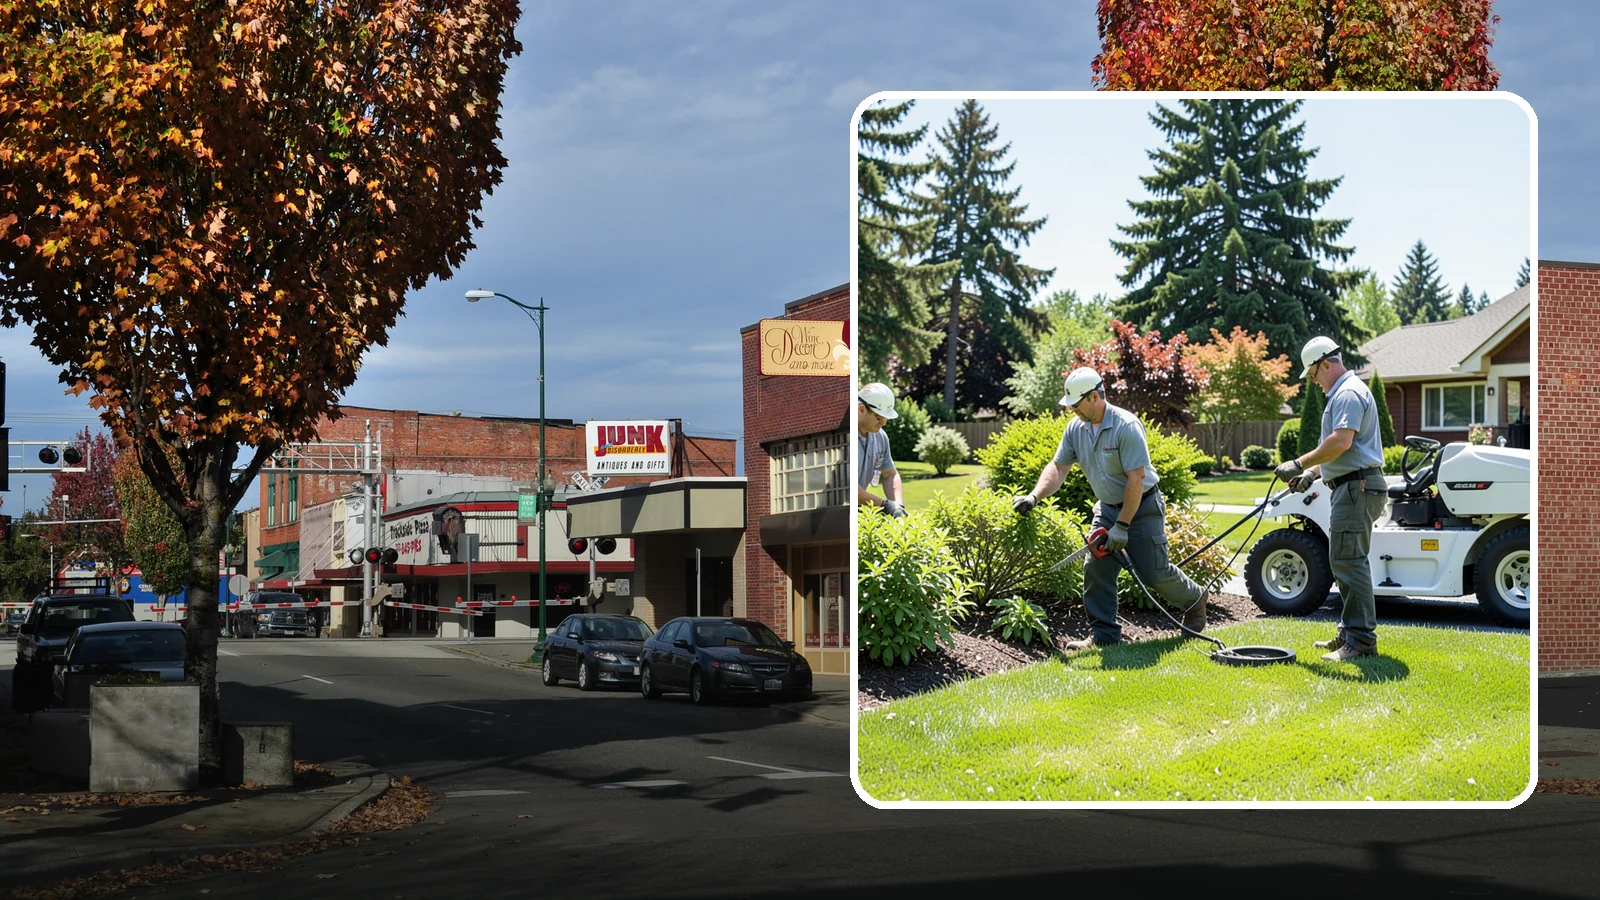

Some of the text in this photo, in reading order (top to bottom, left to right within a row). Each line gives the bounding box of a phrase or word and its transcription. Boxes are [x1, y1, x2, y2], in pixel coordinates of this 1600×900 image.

[596, 425, 665, 457] JUNK
[607, 446, 646, 454] DISORDERLY
[596, 460, 666, 470] ANTIQUES AND GIFTS
[414, 520, 429, 535] Pizza
